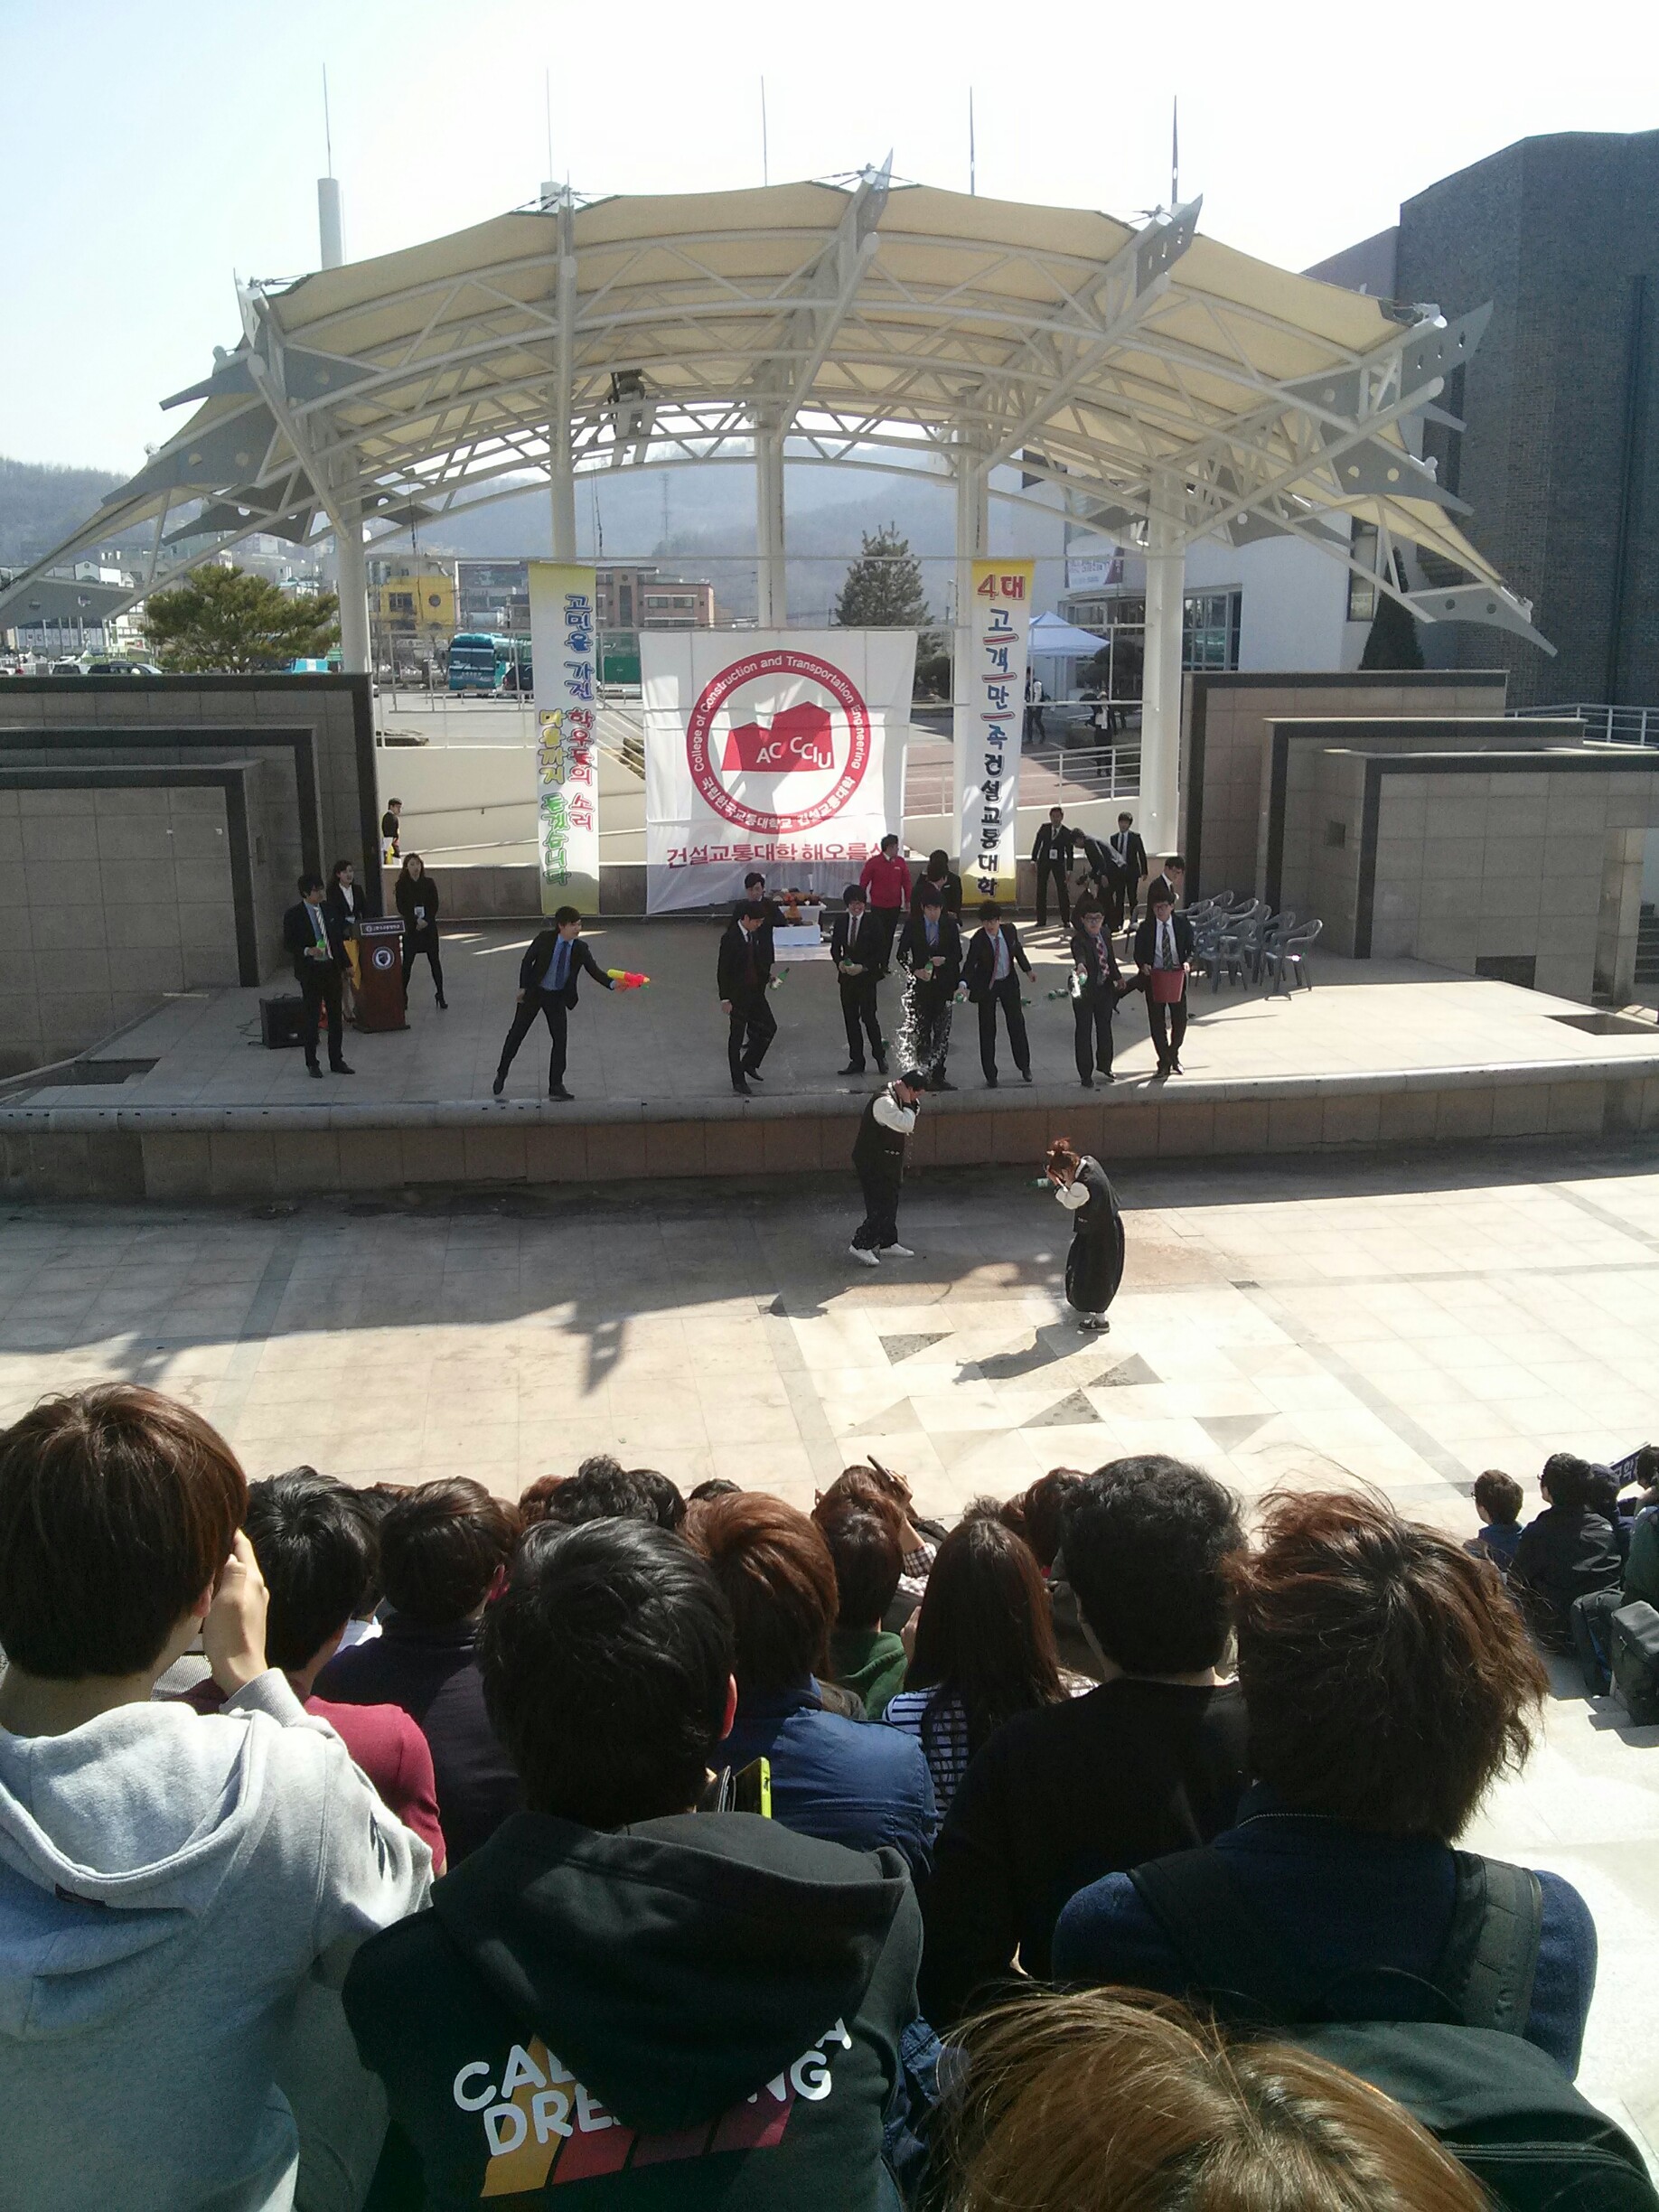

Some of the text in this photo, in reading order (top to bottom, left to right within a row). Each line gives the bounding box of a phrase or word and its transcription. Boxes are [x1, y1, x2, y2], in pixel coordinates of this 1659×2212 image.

[977, 574, 1026, 600] 4대
[564, 593, 594, 653] 고민을
[563, 661, 595, 701] 가진
[691, 655, 866, 772] College of Construction and Transportation Engineering
[667, 843, 798, 869] 건설교통대학
